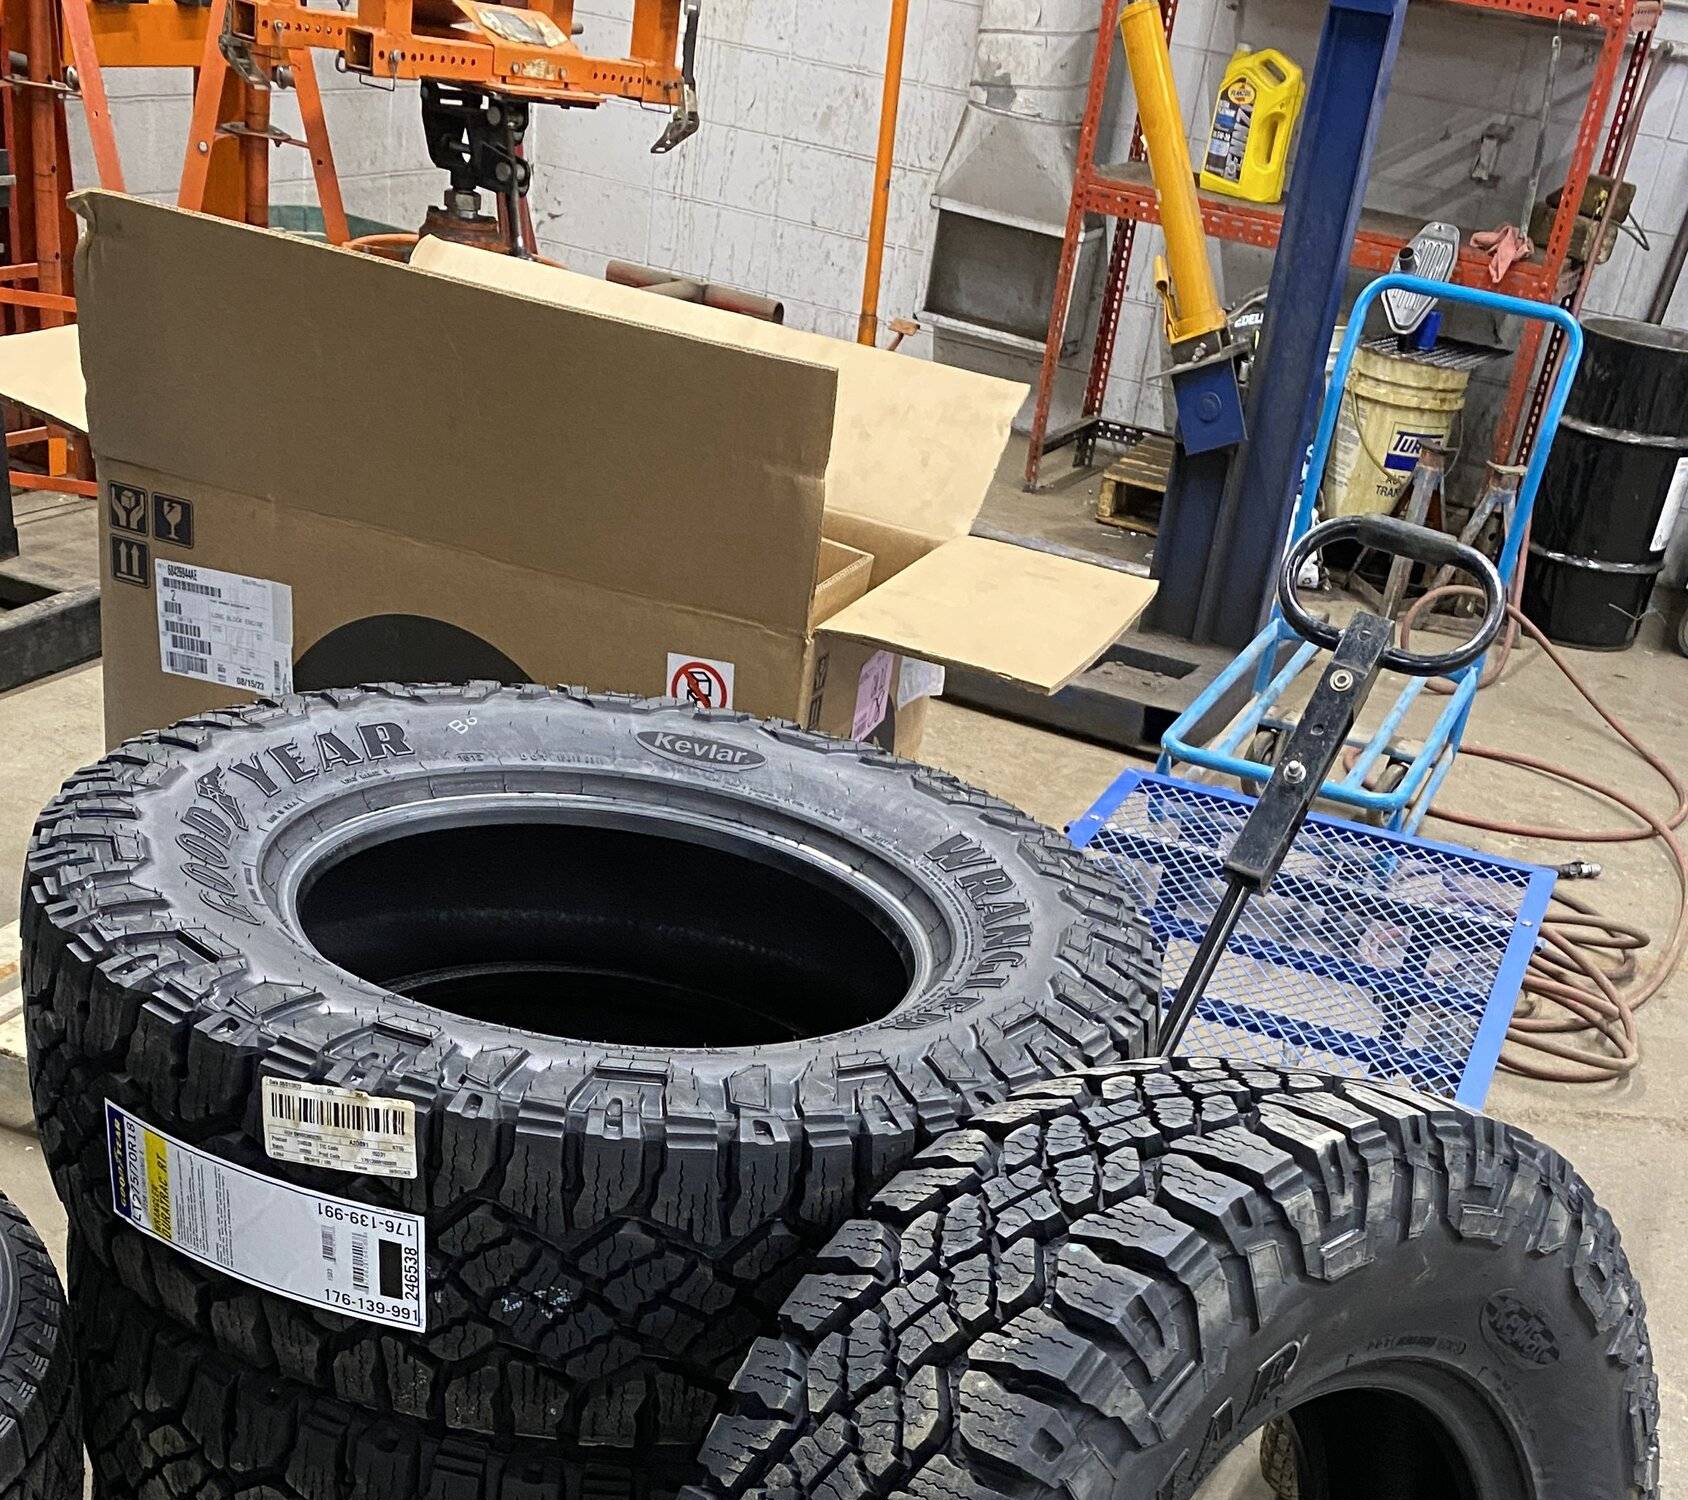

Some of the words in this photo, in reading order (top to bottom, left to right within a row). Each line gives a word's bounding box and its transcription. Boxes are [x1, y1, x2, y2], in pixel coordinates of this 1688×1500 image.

[653, 731, 748, 765] Kevlar
[126, 1120, 142, 1222] LT275/70R18
[156, 1152, 168, 1175] RT
[155, 1175, 173, 1240] DURATRAC
[317, 1202, 413, 1237] 176-139-991
[404, 1246, 419, 1301] 246538
[325, 1288, 418, 1321] 176-139-991
